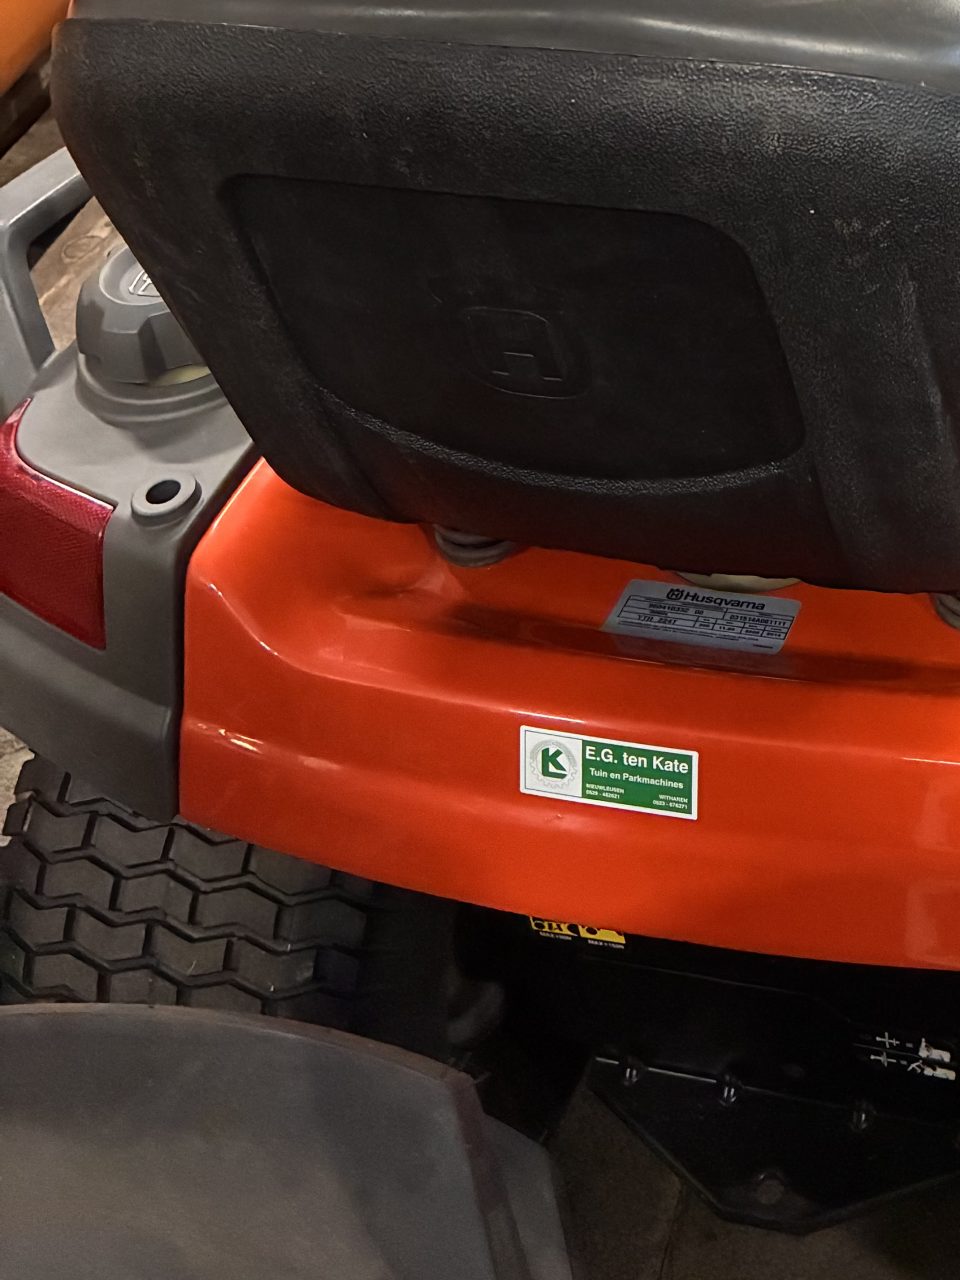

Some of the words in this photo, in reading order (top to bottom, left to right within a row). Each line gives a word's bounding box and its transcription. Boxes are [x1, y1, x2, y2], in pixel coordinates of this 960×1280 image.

[684, 591, 766, 611] Husqvarna
[585, 745, 618, 764] E.G.
[622, 752, 648, 768] ten
[652, 756, 689, 774] Kate
[589, 767, 608, 778] Tuin
[609, 772, 621, 780] en
[622, 772, 684, 789] Parkmachines
